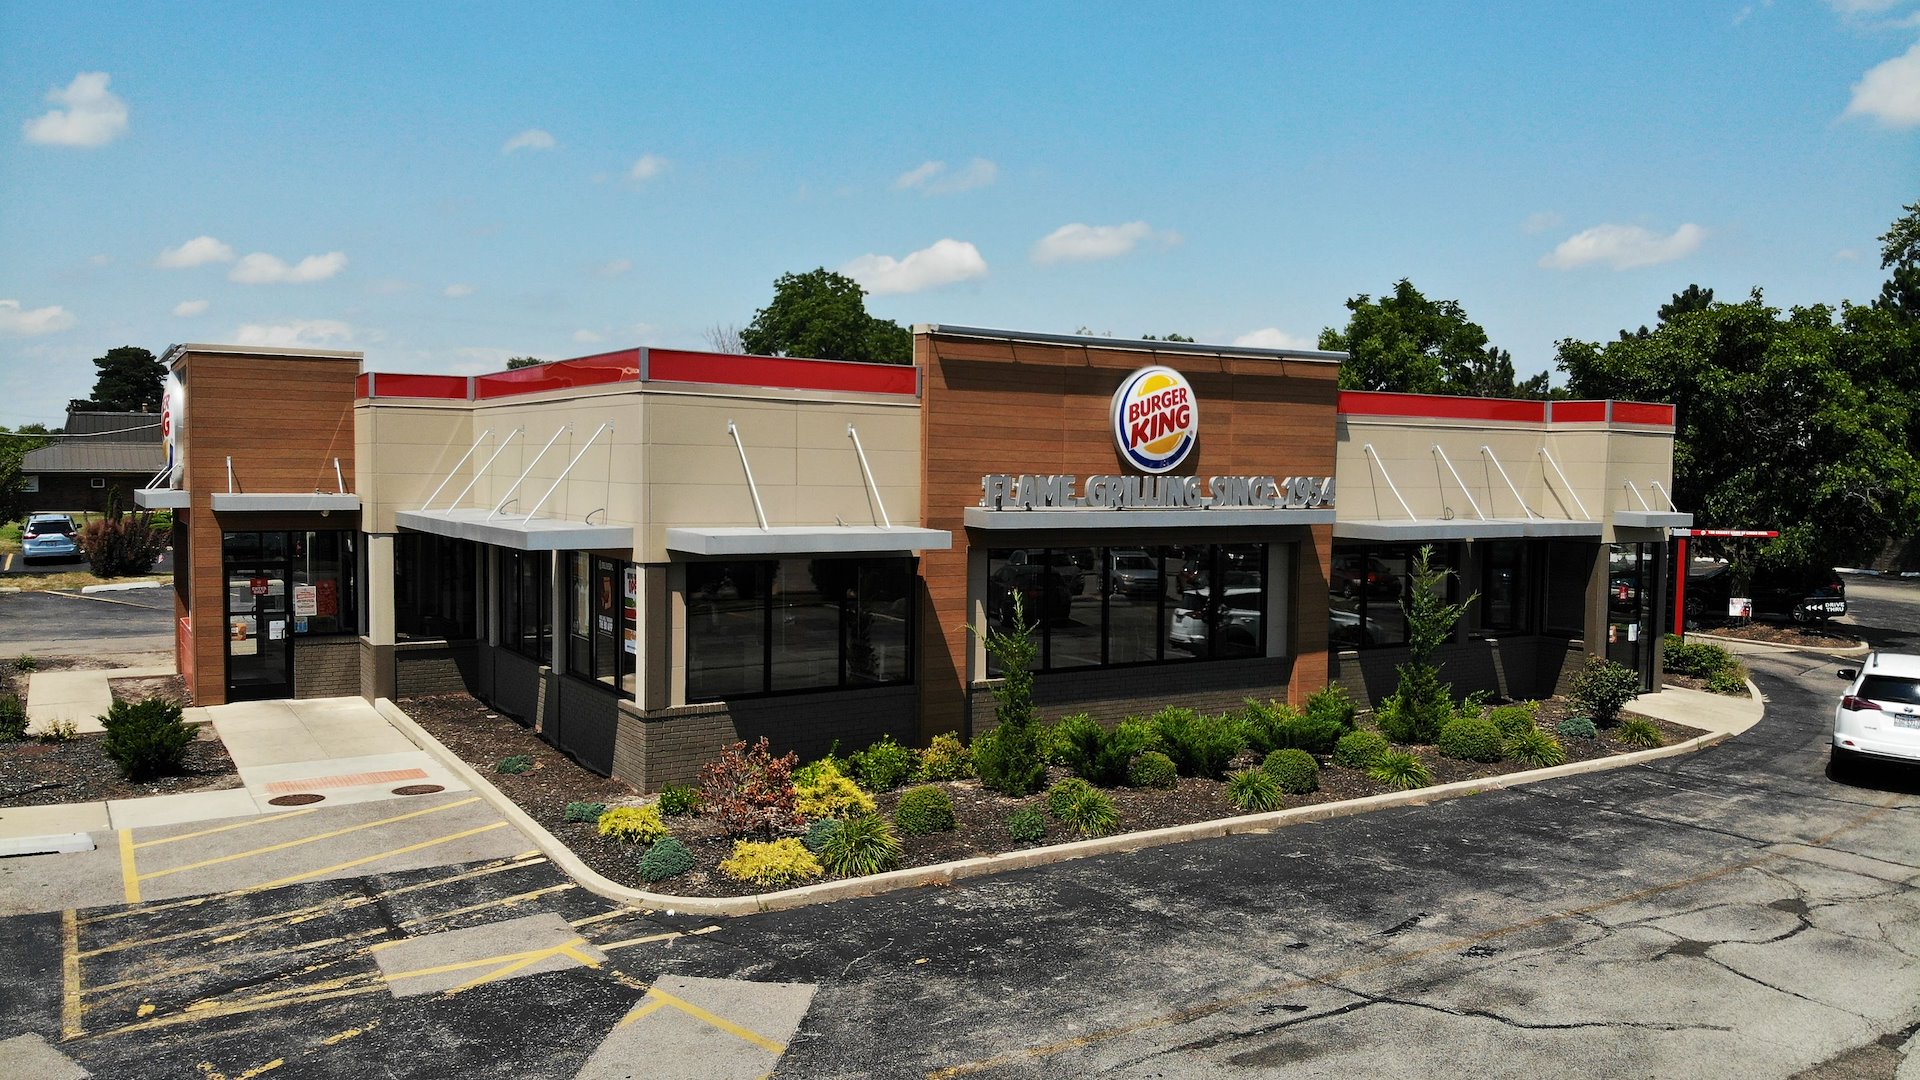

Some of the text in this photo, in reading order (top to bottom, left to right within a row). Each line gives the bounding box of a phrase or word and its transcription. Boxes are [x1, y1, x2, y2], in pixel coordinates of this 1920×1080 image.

[1129, 387, 1187, 423] BURGER
[1131, 404, 1190, 449] KING
[985, 474, 1336, 508] FLAME GRILLING SINCE 1954
